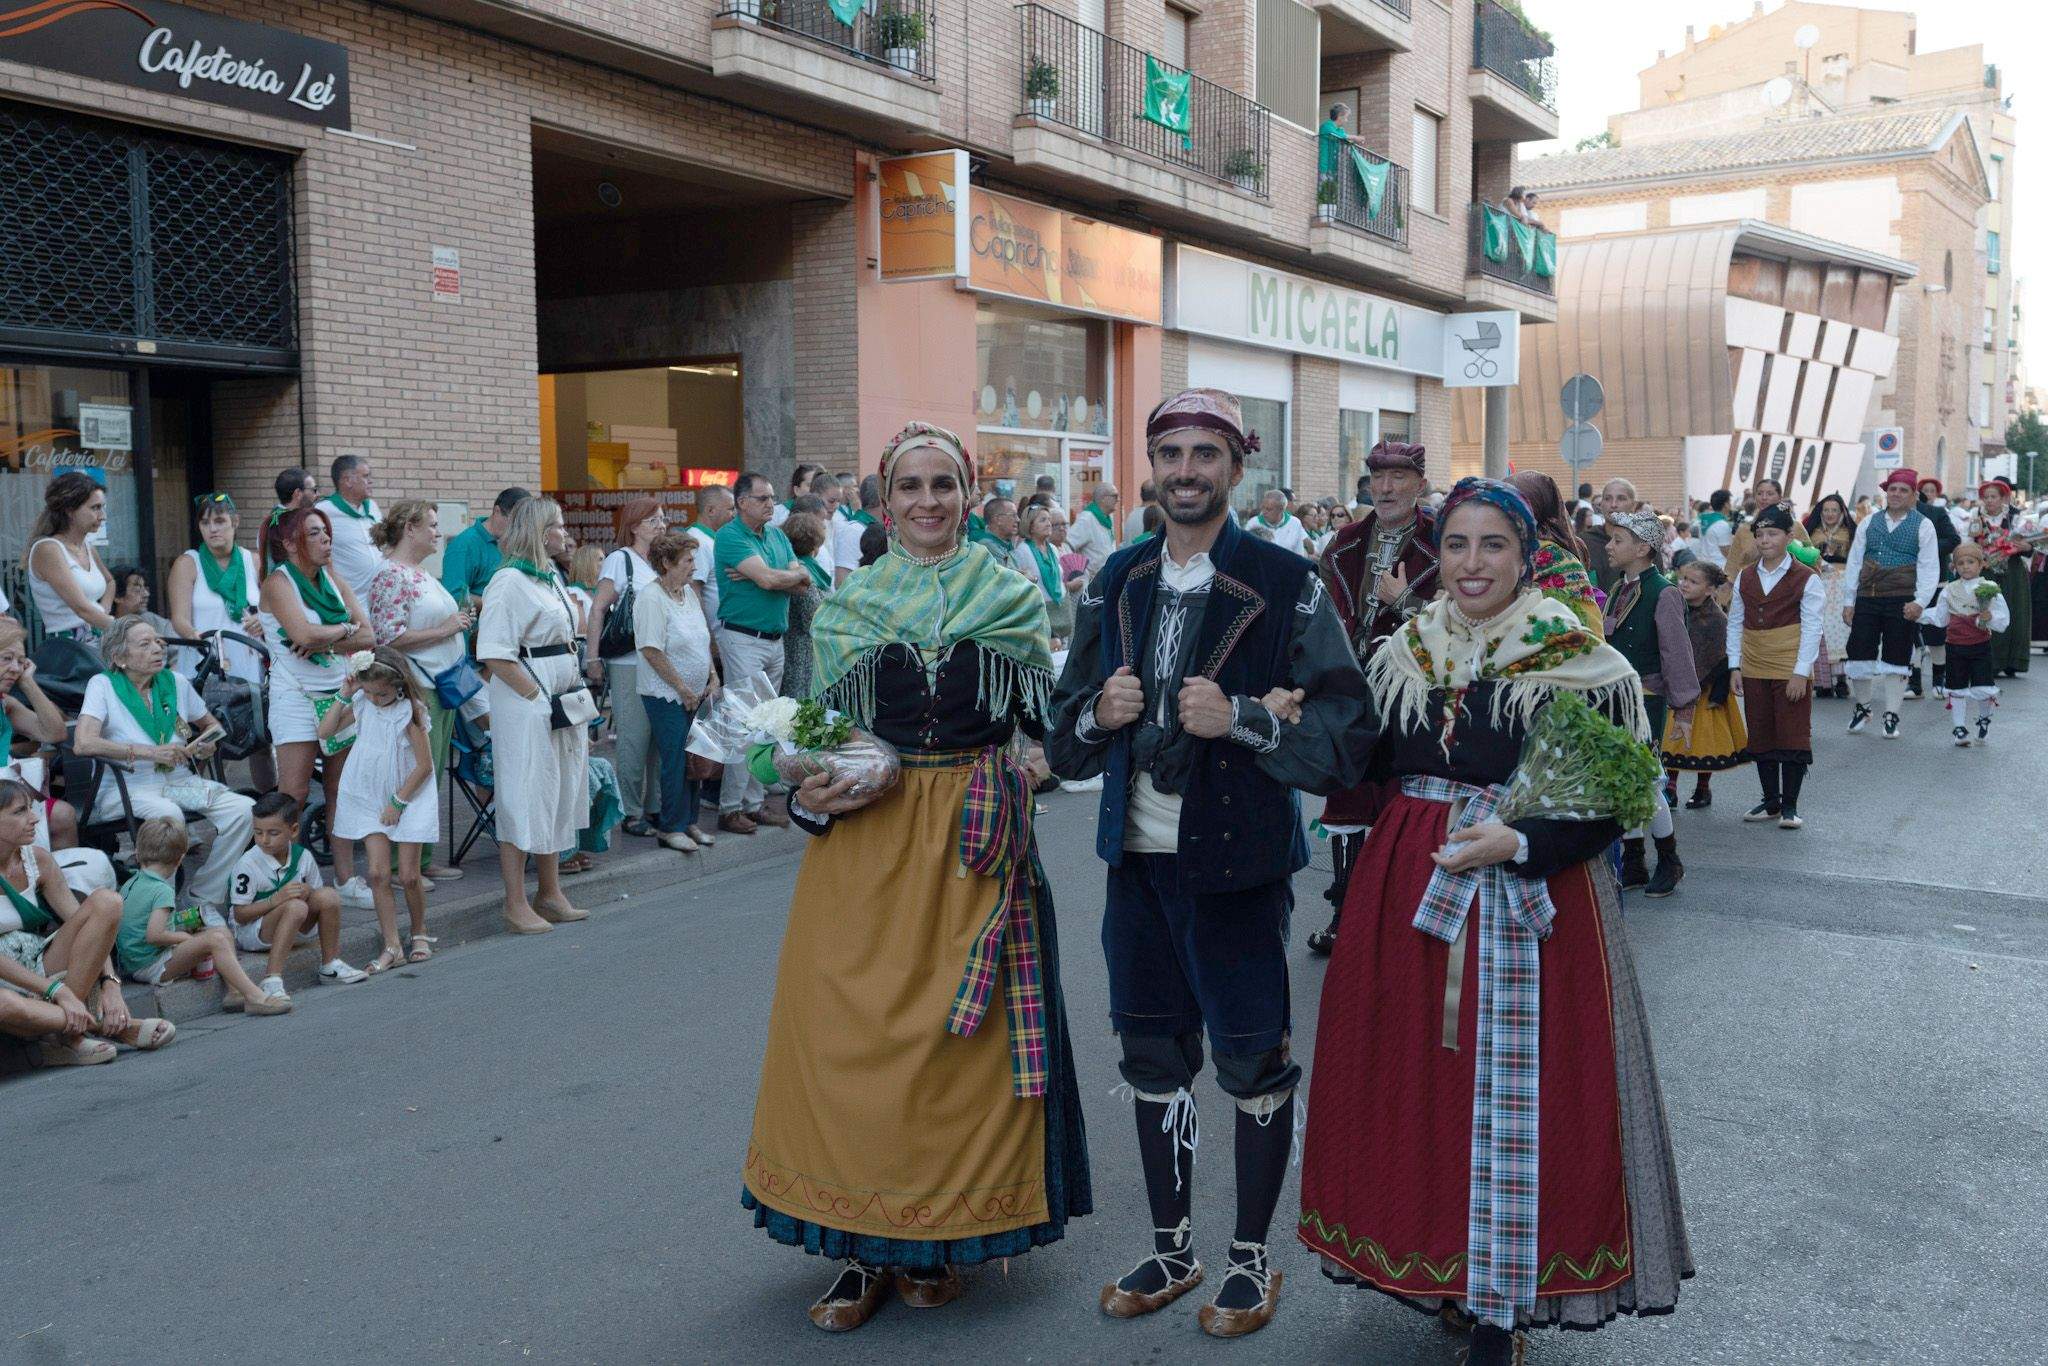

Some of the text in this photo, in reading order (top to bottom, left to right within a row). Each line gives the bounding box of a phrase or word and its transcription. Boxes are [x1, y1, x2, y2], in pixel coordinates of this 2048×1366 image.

[138, 27, 336, 111] Cafetería Lei
[880, 195, 957, 222] Capricho
[970, 213, 1058, 272] Capricho
[1250, 272, 1399, 361] MICAELA
[24, 445, 128, 473] Cafetería Lei
[236, 873, 250, 895] 3
